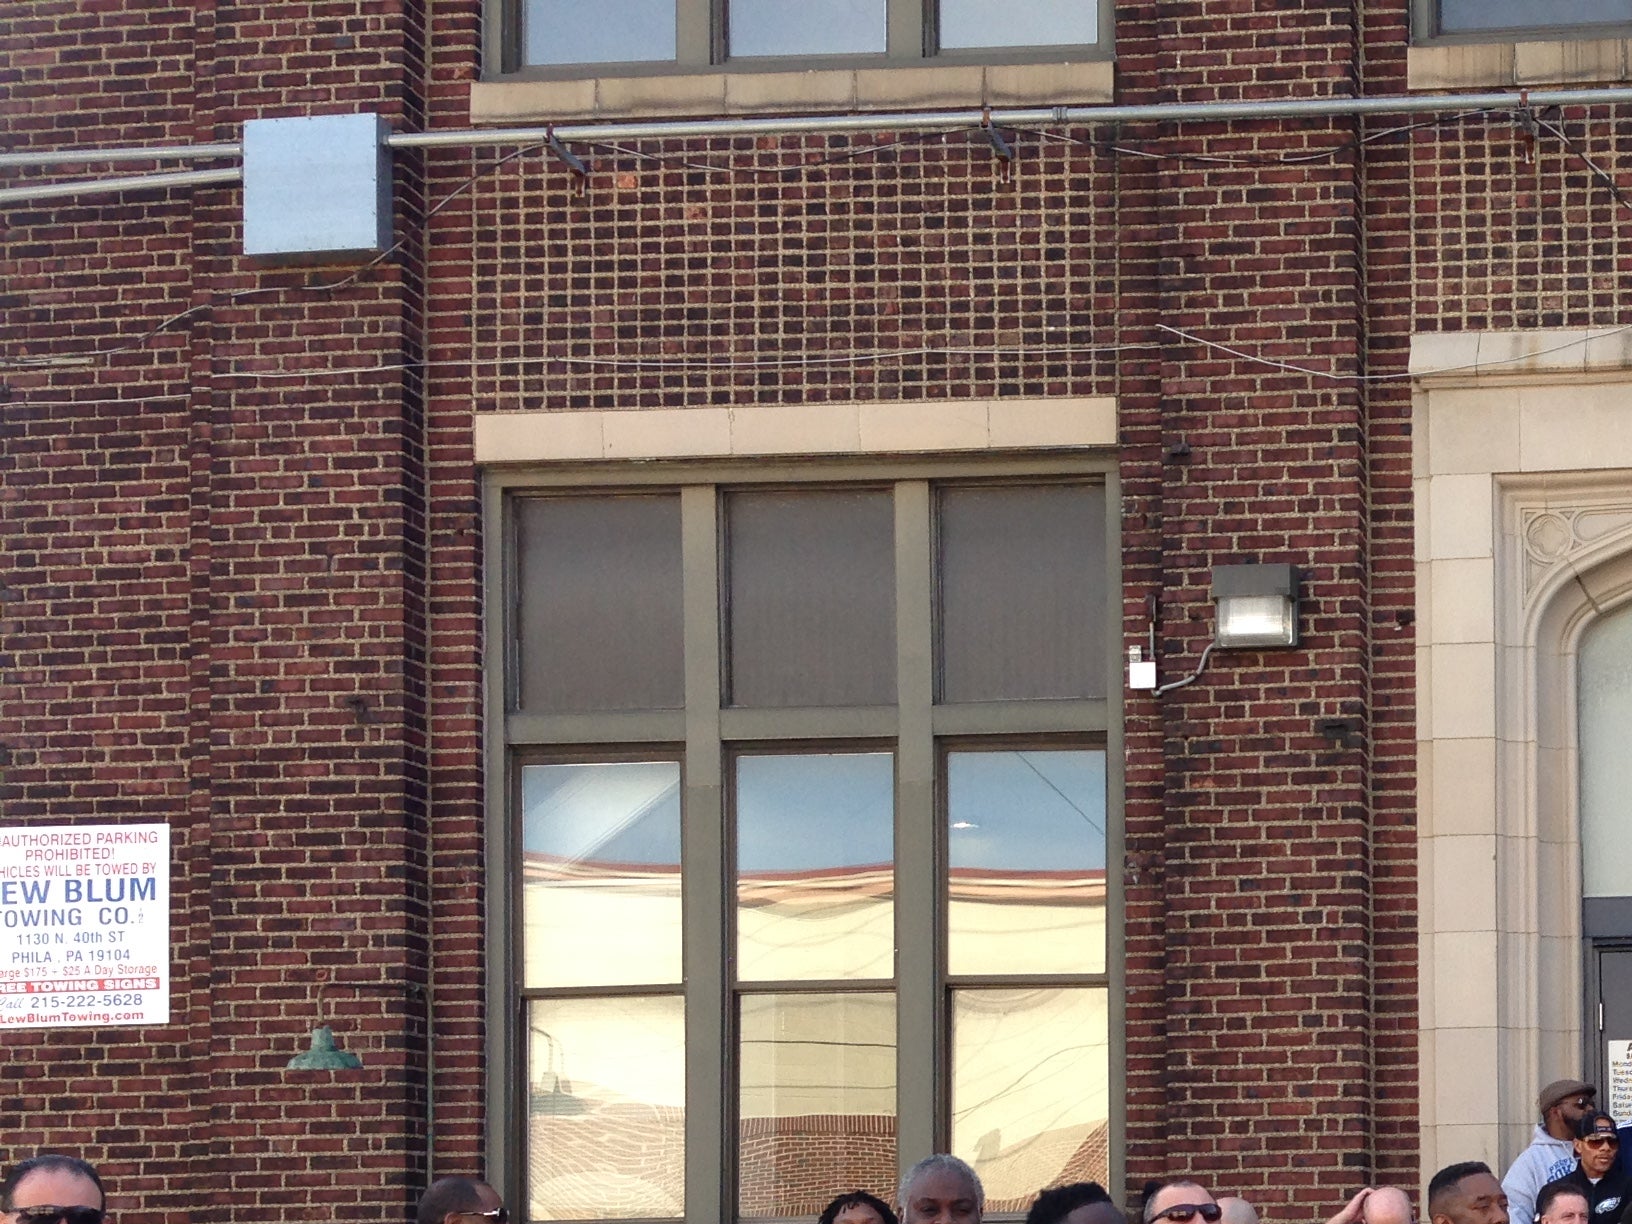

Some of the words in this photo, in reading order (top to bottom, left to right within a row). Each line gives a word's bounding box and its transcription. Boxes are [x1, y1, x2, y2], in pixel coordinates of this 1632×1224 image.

[0, 832, 91, 847] AUTHORIZED
[97, 831, 158, 845] PARKING
[25, 847, 115, 861] PROHIBITED!
[44, 865, 72, 877] WILL
[76, 864, 91, 876] BE
[95, 862, 138, 876] TOWED
[142, 862, 157, 875] BY
[65, 877, 156, 903] BLUM
[99, 906, 134, 925] CO.
[17, 932, 49, 945] 1130
[74, 931, 102, 943] 40th
[108, 931, 125, 943] ST
[66, 950, 83, 962] PA
[89, 949, 130, 961] 19104
[24, 966, 48, 978] $175
[62, 965, 80, 976] $25
[84, 965, 91, 975] A
[95, 964, 114, 977] Day
[117, 963, 158, 977] Storage
[31, 979, 99, 992] TOWING
[103, 978, 157, 990] SIGNS
[31, 993, 143, 1009] 215-222-5628
